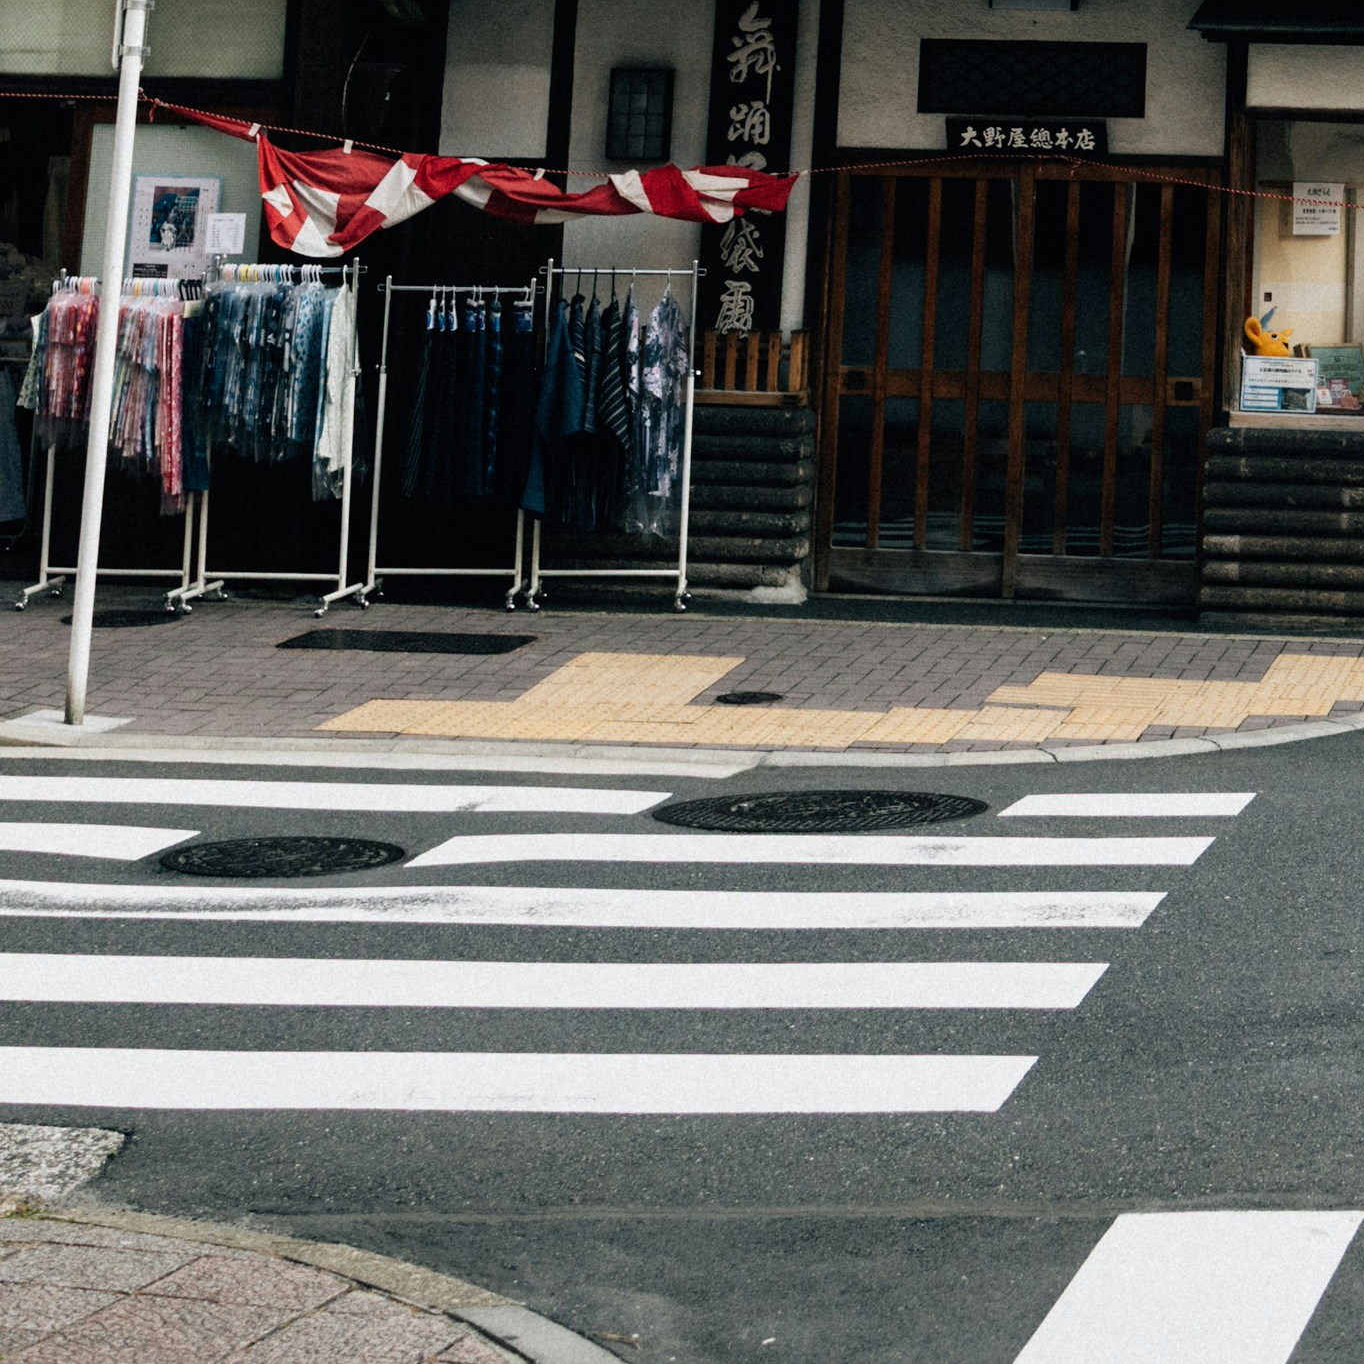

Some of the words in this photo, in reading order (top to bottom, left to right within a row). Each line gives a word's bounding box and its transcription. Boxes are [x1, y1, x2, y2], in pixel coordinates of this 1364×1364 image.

[959, 126, 1096, 151] 大野屋總本店
